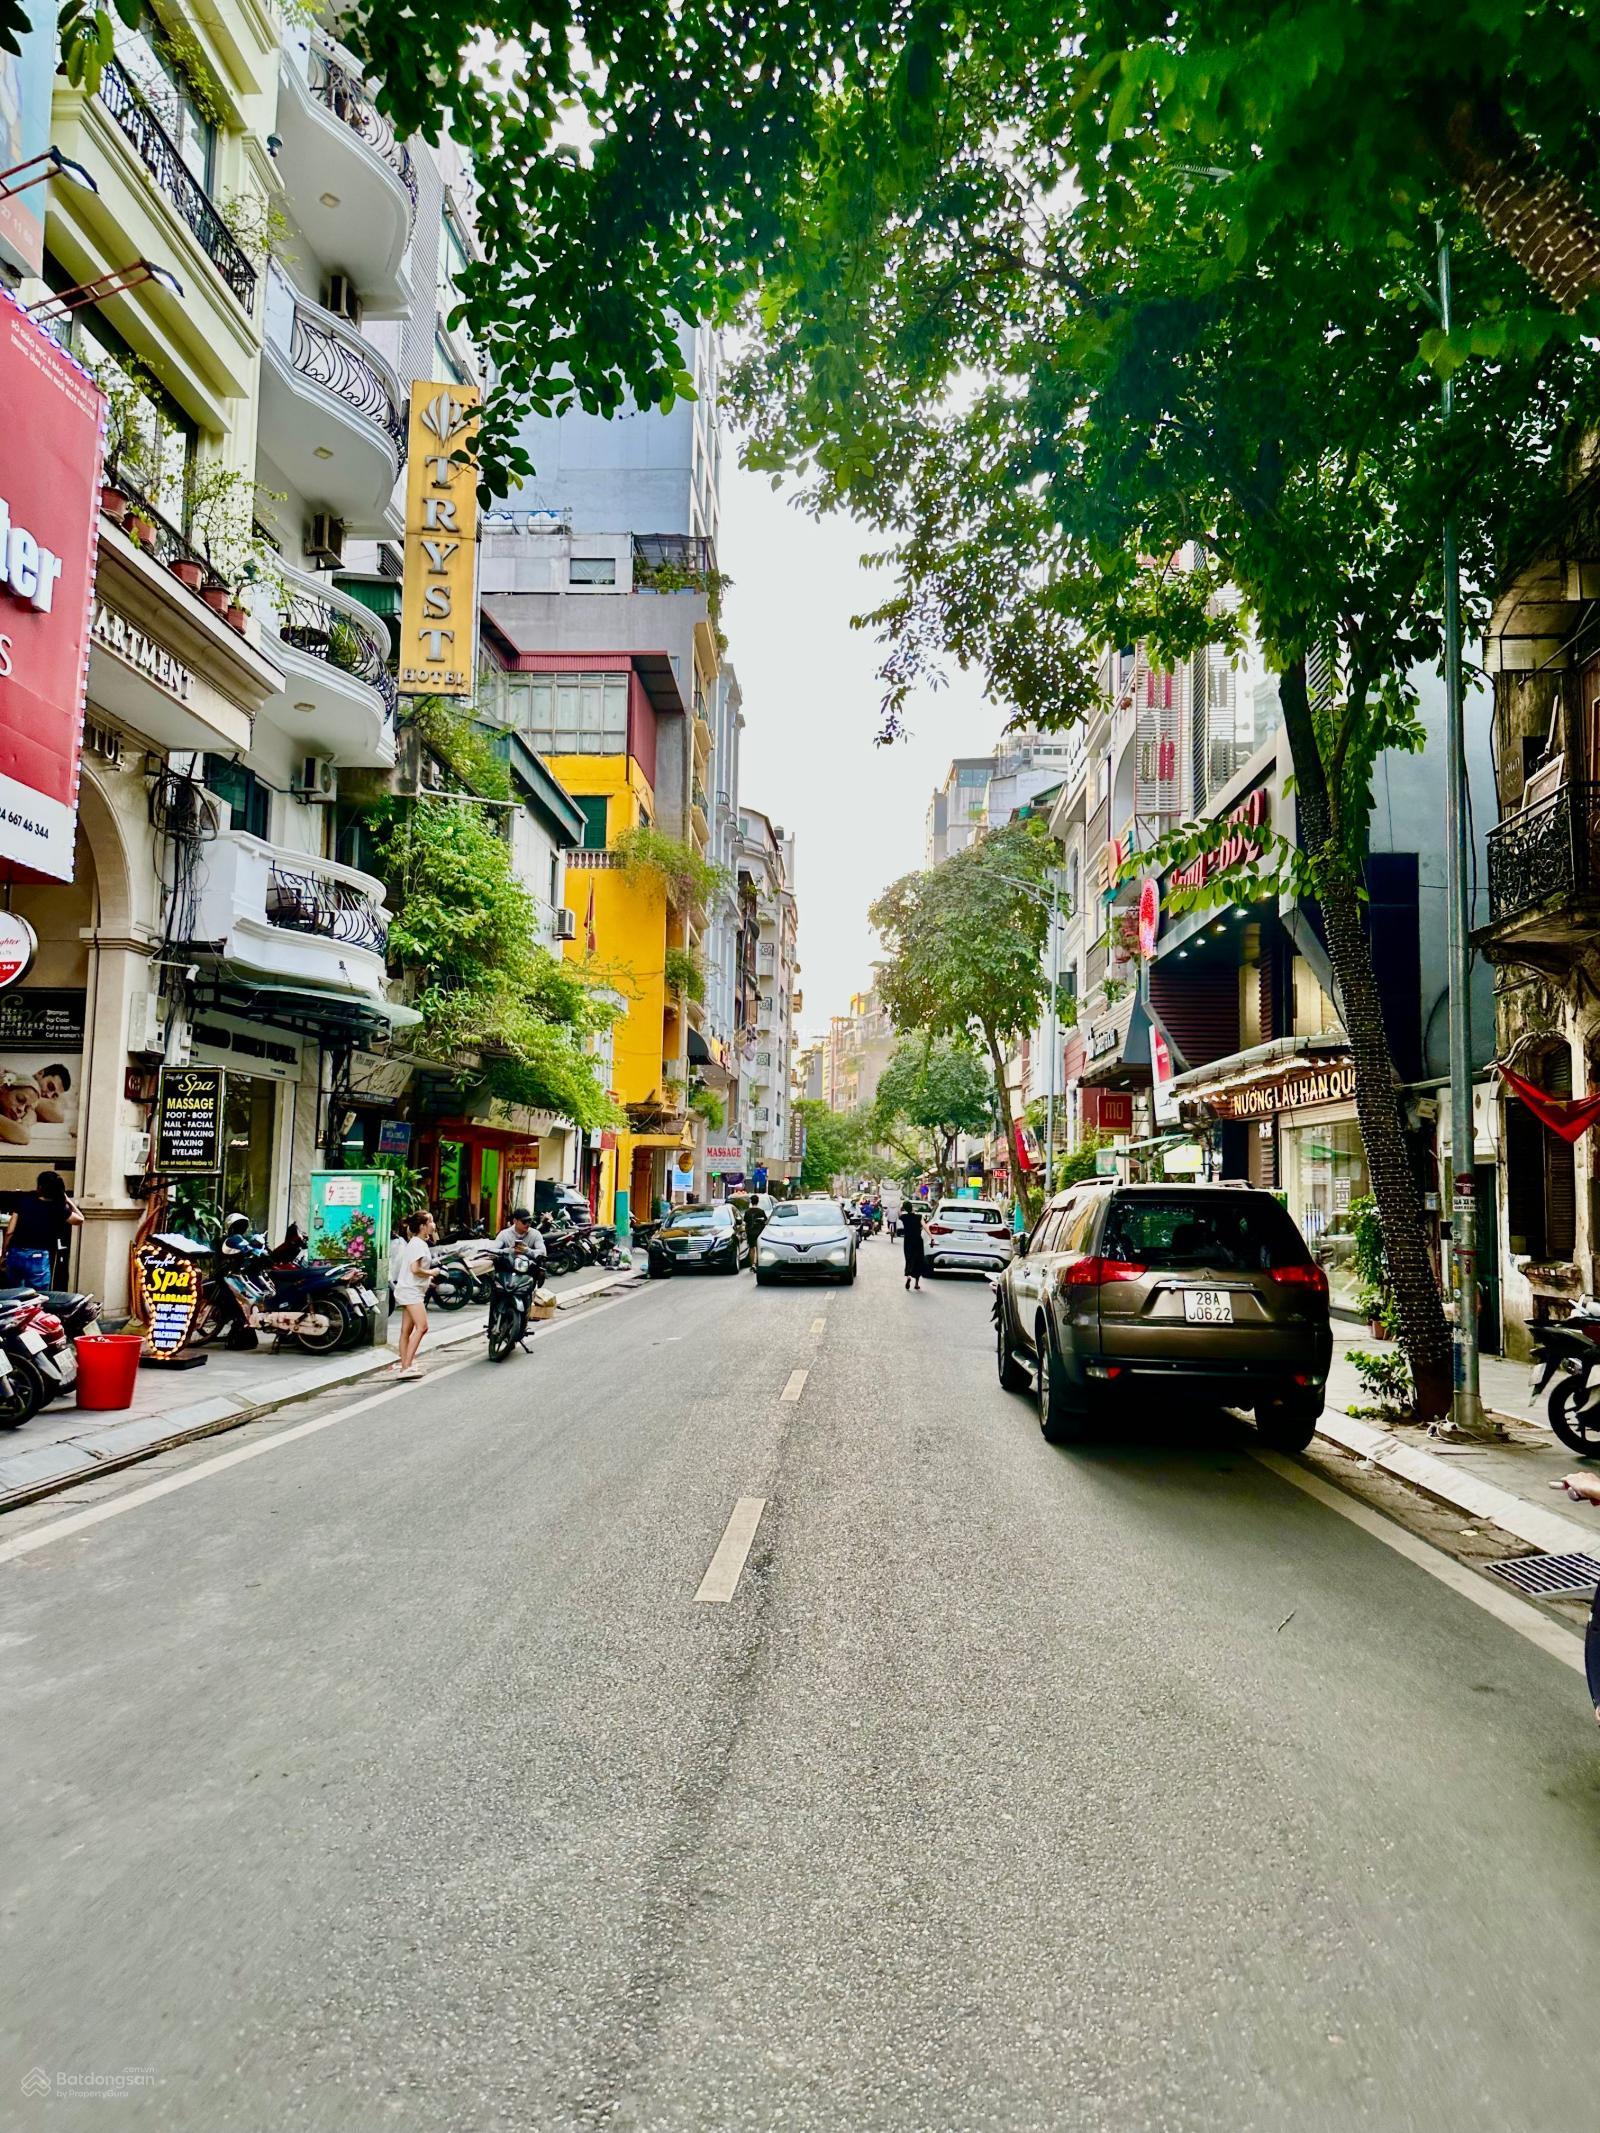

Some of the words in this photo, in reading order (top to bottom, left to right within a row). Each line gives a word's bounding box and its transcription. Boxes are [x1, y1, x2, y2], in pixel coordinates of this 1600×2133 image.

[418, 455, 460, 662] TRYST
[8, 811, 22, 827] 667
[23, 819, 33, 832] 46
[34, 823, 49, 839] 344
[178, 1073, 216, 1096] Spa
[1234, 1085, 1273, 1115] NƯỚNG
[1299, 1070, 1329, 1103] HÀN
[167, 1098, 214, 1109] MASSAGE
[191, 1111, 214, 1119] BODY
[172, 1139, 204, 1147] WAXING
[706, 1147, 742, 1158] MASSAGE
[147, 1267, 190, 1292] Spa
[152, 1293, 194, 1303] MASSAGE
[1196, 1292, 1220, 1305] 28A
